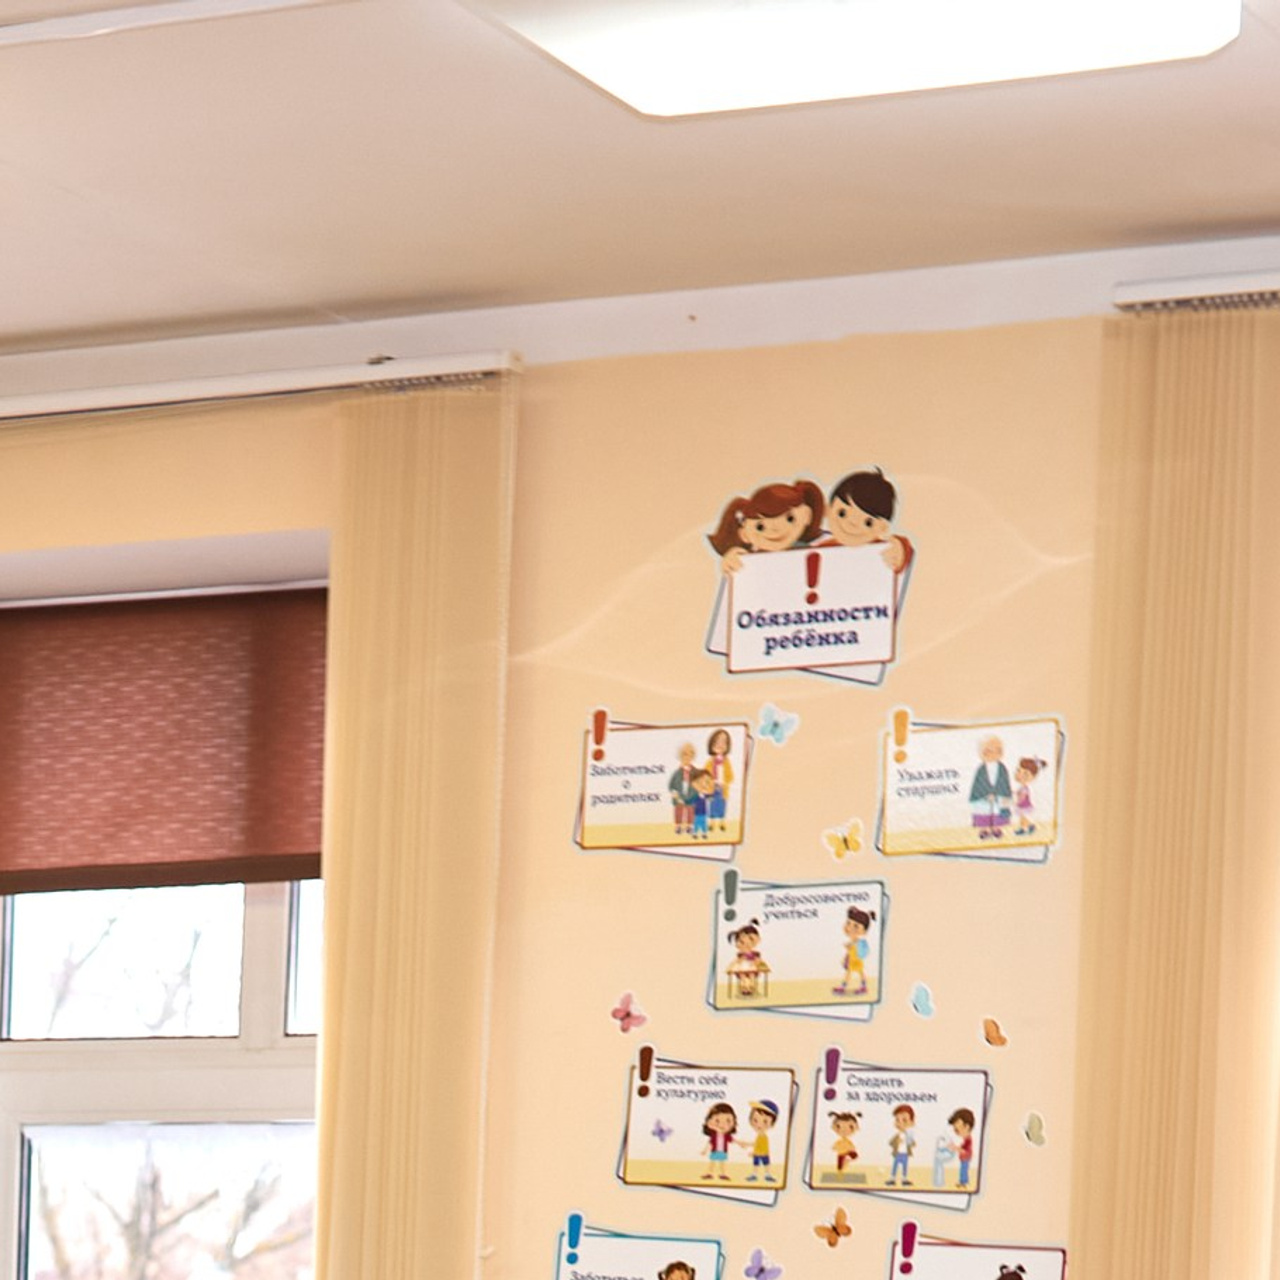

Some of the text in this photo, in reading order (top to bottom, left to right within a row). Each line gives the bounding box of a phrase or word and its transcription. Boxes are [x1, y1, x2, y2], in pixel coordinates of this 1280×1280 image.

[737, 604, 889, 629] Обязанности
[764, 628, 859, 655] ребёнка
[656, 1072, 728, 1086] Вести себя
[847, 1074, 904, 1088] Следить
[656, 1088, 726, 1102] культурно
[847, 1091, 861, 1101] за
